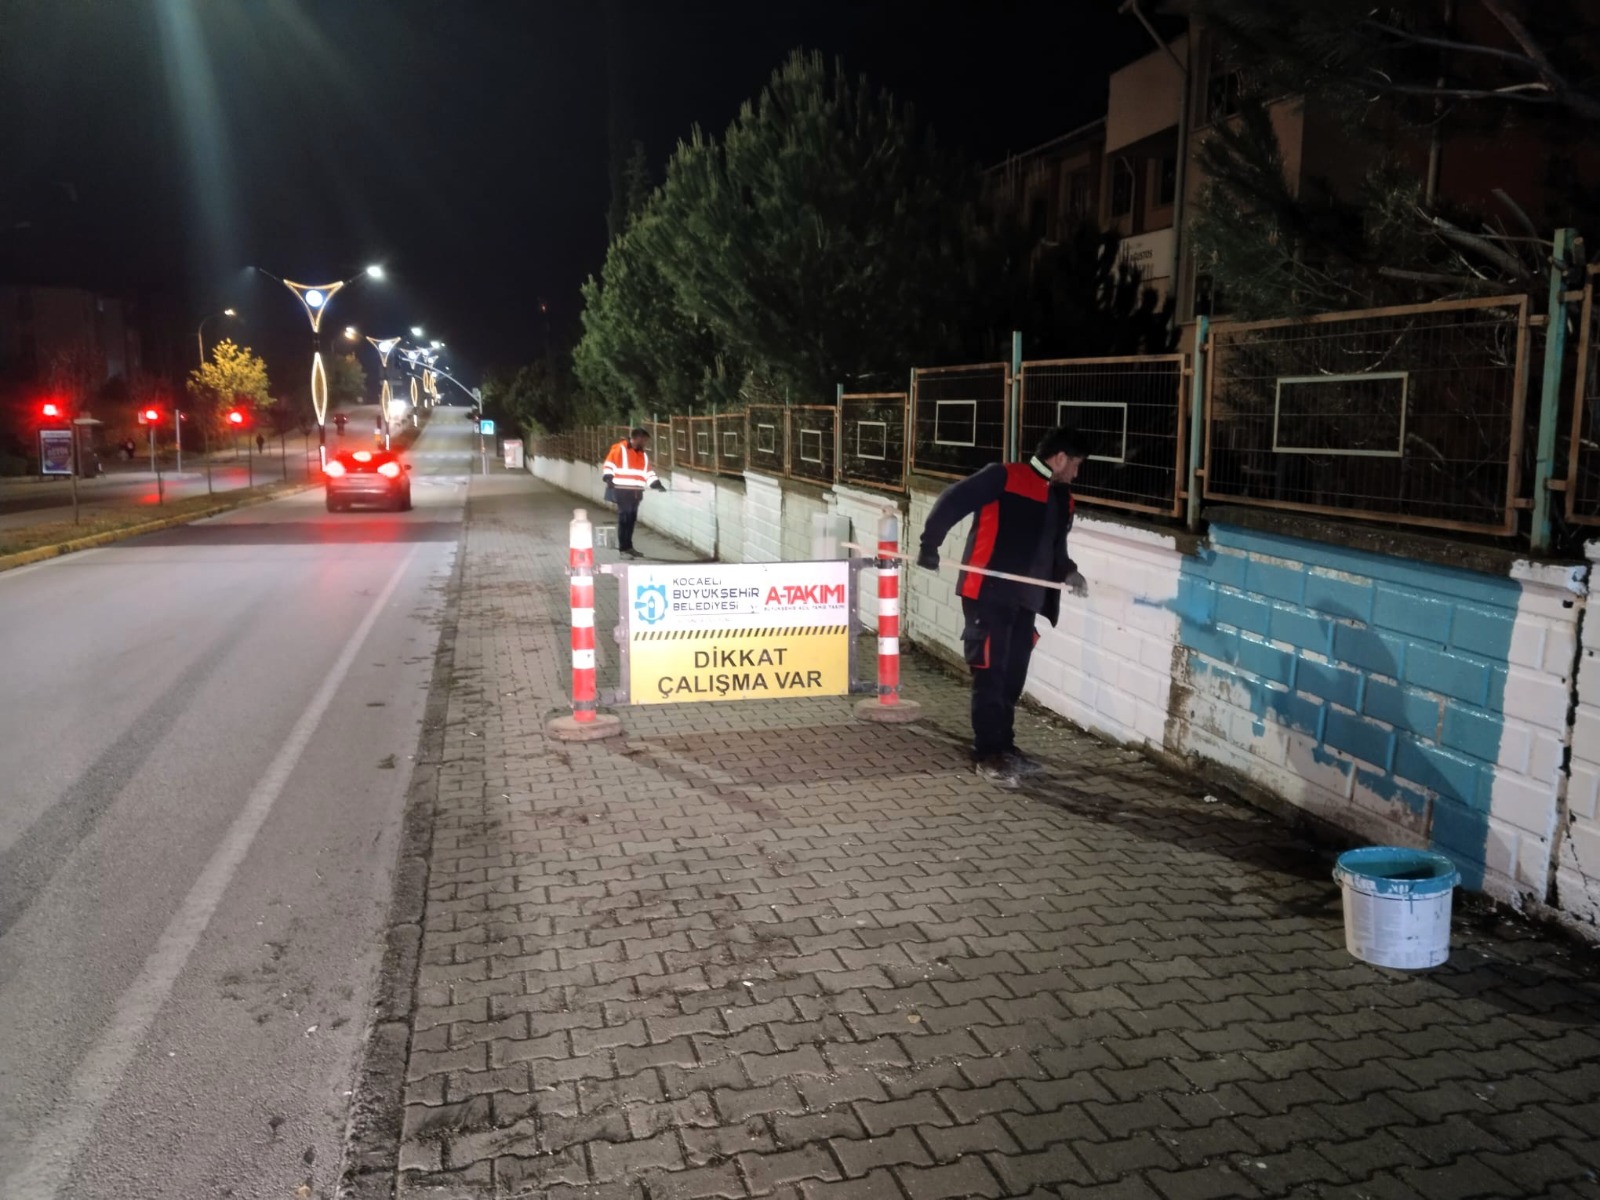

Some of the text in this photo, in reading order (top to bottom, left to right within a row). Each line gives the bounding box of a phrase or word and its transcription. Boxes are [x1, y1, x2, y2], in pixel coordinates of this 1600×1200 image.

[673, 587, 759, 599] BÜYÜKŞEHİR
[764, 584, 845, 605] A-TAKIMI
[673, 601, 739, 611] BELEDİYESİ
[694, 646, 787, 669] DİKKAT
[657, 670, 822, 699] ÇALIŞMA VAR
